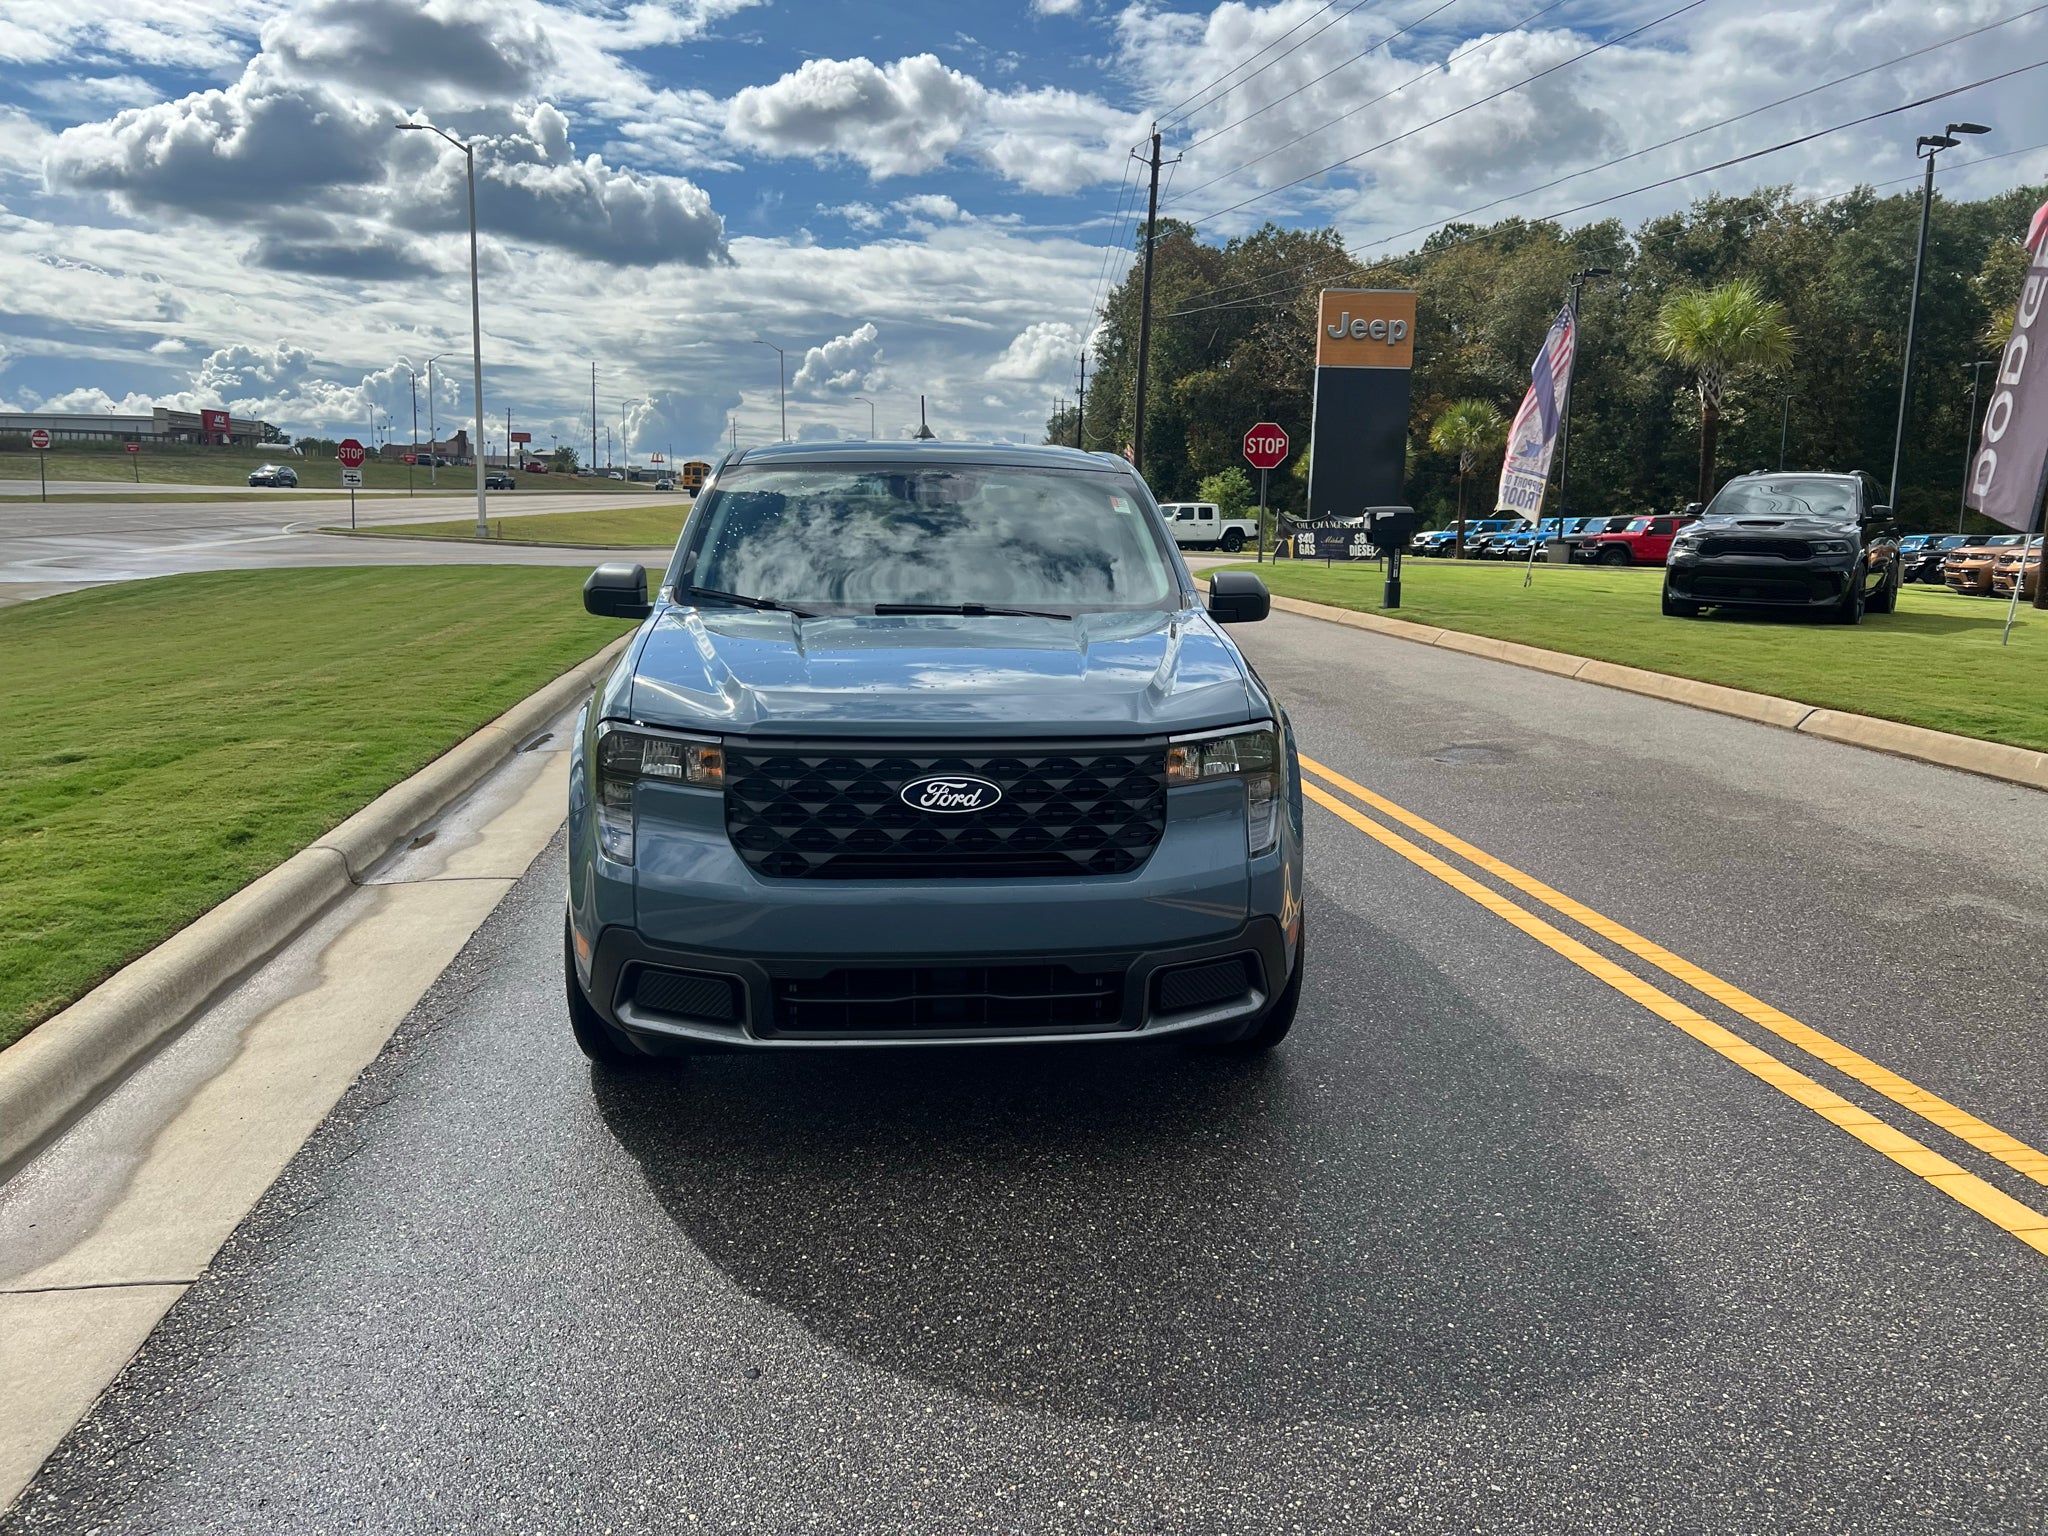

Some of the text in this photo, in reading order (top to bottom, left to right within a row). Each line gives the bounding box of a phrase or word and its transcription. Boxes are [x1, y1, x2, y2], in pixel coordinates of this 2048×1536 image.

[1327, 311, 1408, 345] Jeep
[1246, 437, 1286, 454] STOP
[340, 447, 363, 460] STOP
[1311, 520, 1343, 529] CHANGE
[1343, 520, 1364, 529] SPEC
[1298, 532, 1315, 544] $40
[1354, 532, 1368, 545] $8
[1299, 544, 1316, 555] GAS
[1349, 544, 1377, 557] DIESEL
[920, 781, 983, 807] Ford
